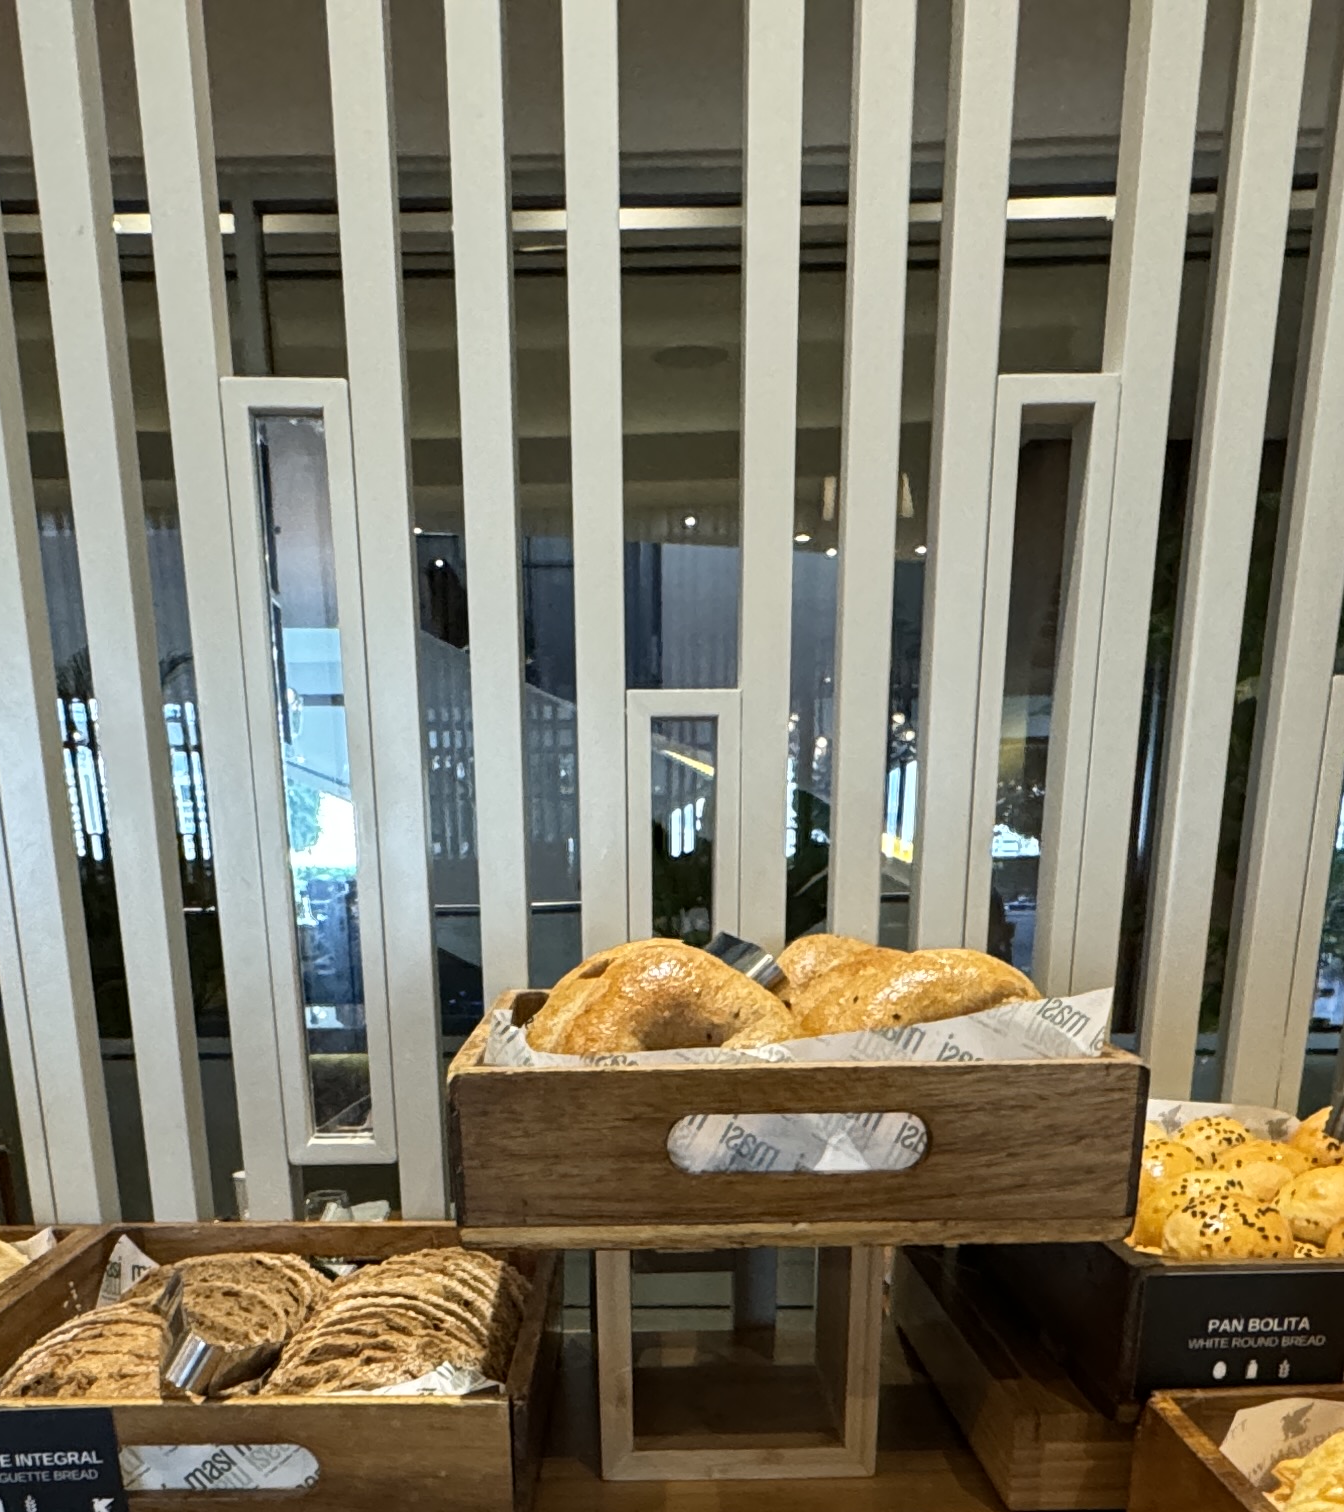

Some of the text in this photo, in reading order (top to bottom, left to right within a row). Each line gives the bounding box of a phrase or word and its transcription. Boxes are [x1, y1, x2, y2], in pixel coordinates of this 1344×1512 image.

[1207, 1316, 1310, 1333] PAN BOLITA
[1187, 1334, 1326, 1350] WHITE ROUND BREAD
[15, 1450, 104, 1467] INTEGRAL
[53, 1468, 99, 1482] BREAD
